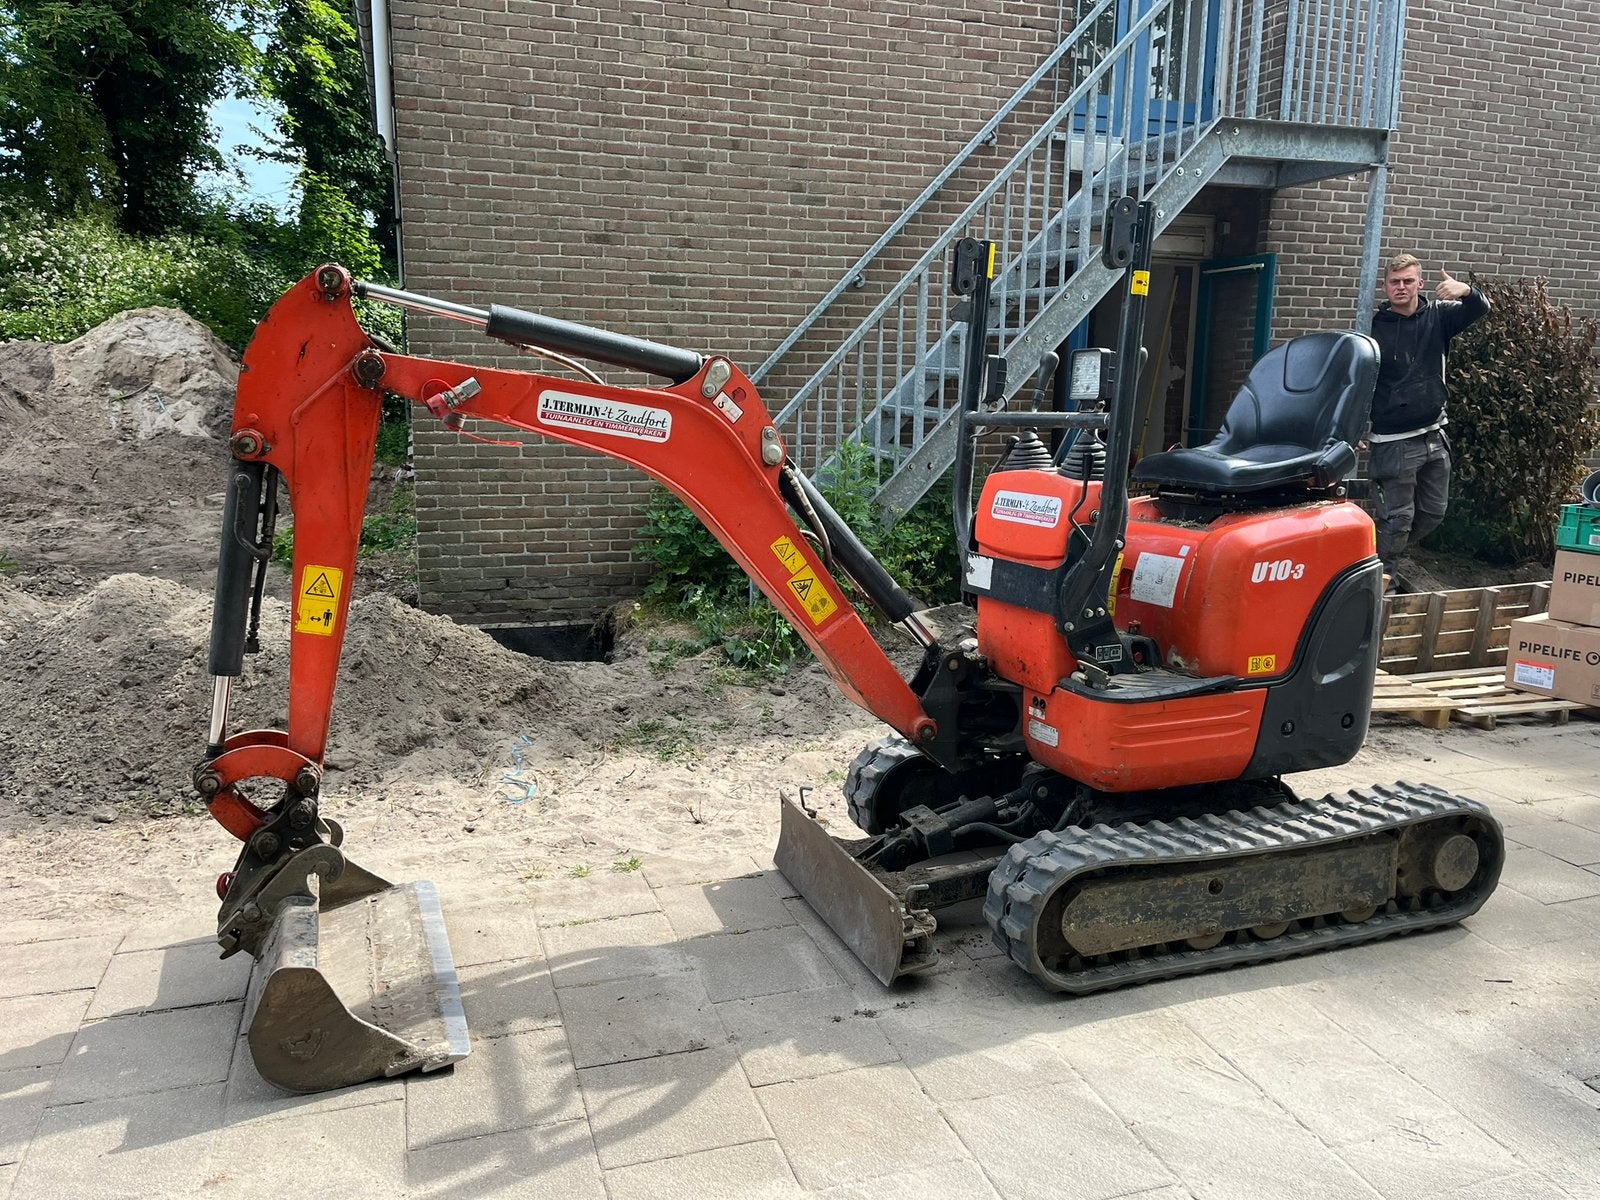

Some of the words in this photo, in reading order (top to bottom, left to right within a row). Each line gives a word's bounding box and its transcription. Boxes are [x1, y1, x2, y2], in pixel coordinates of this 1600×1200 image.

[545, 412, 592, 426] TUINAANLEG
[604, 422, 664, 437] TIMMERWERKEN
[615, 409, 668, 436] Zandfort
[1251, 559, 1305, 583] U10-3
[1519, 640, 1581, 662] PIPELIFE
